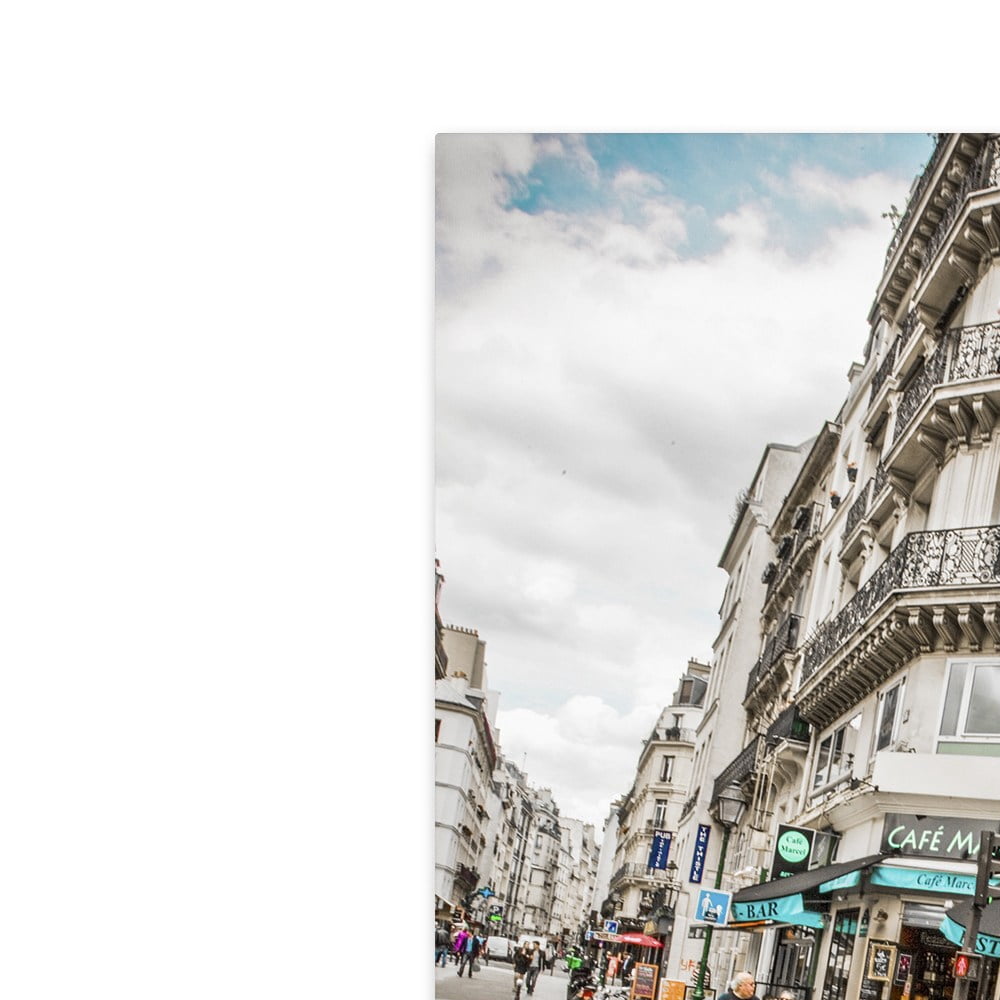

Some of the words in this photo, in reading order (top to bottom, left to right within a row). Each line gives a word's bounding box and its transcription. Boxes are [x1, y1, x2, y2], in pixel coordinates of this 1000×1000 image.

[655, 830, 671, 840] PUB
[786, 835, 804, 845] Café
[887, 824, 944, 852] CAFÉ
[780, 844, 807, 857] Marcel
[916, 873, 942, 890] Café
[746, 901, 778, 919] BAR
